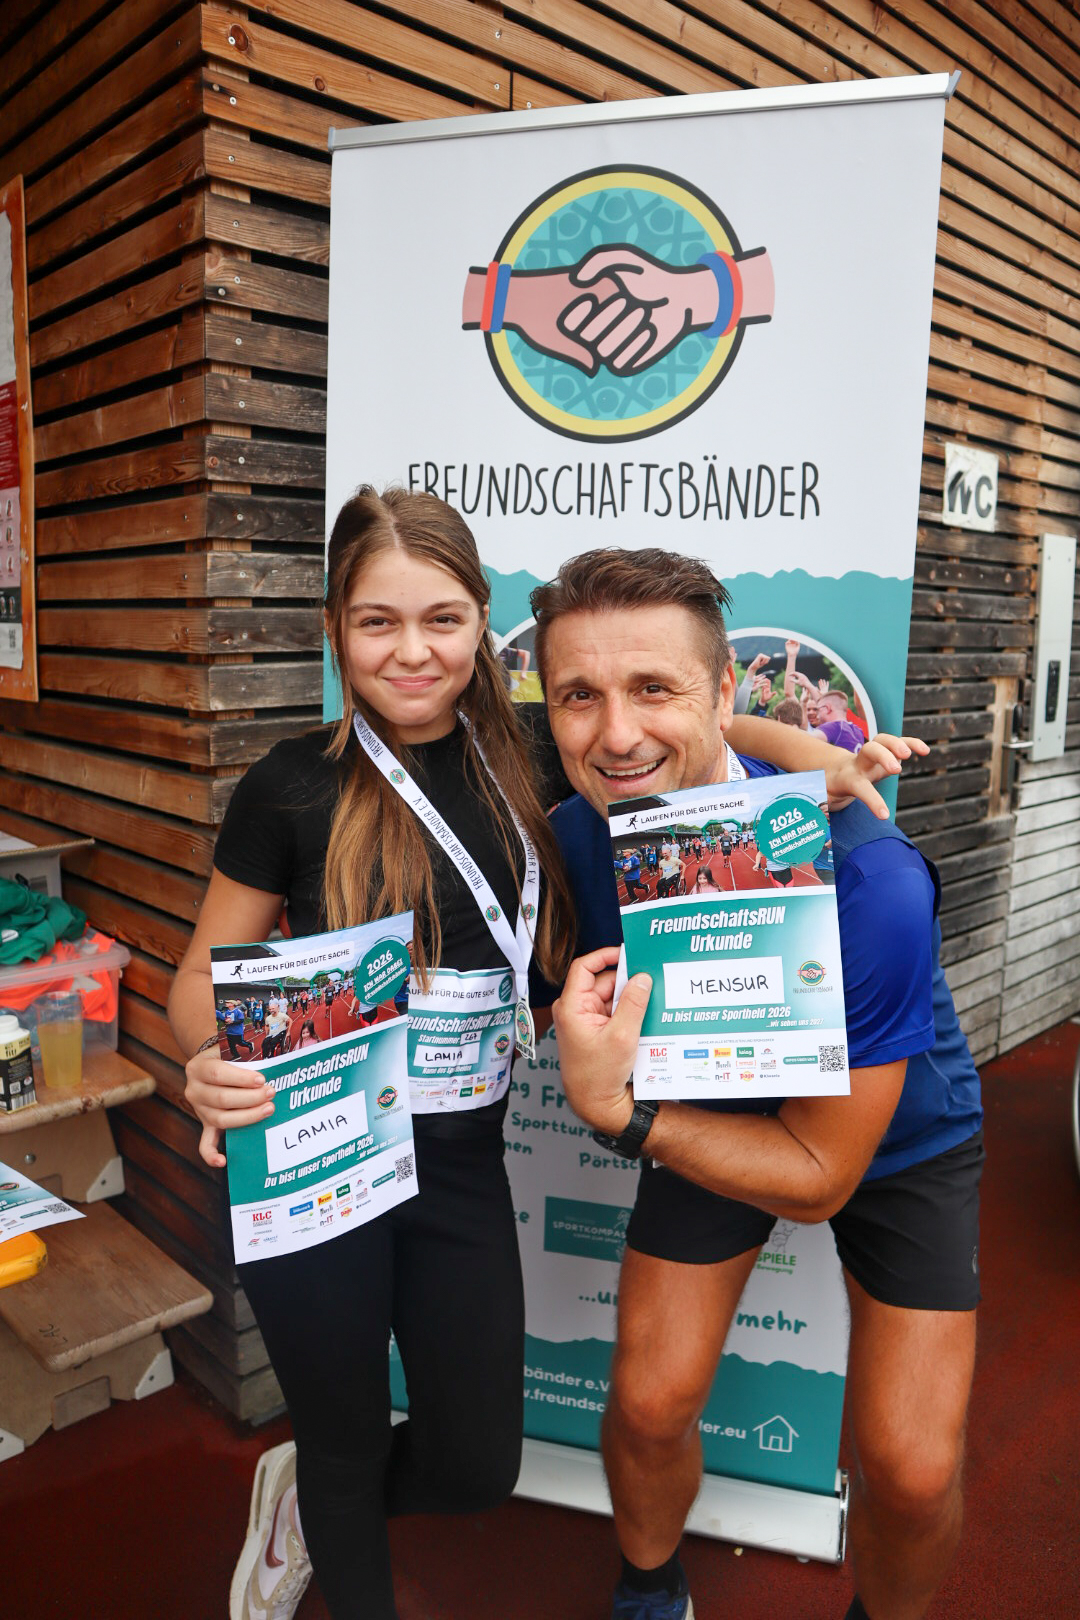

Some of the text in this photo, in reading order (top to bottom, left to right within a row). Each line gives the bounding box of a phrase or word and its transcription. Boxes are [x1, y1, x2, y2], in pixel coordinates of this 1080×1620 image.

[408, 455, 820, 520] FREUNDSCHAFTSBÄNDER
[948, 470, 993, 518] WC
[640, 800, 745, 824] LAUFEN FÜR DIE GUTE SACHE
[770, 807, 803, 830] 2026
[769, 819, 819, 849] ICH WAR DABEI
[650, 906, 786, 936] FreundschaftsRUN
[690, 932, 753, 952] Urkunde
[247, 949, 350, 974] LAUFEN FÜR DIE GUTE SACHE
[367, 950, 393, 975] 2026
[408, 988, 433, 997] AUFN
[435, 989, 451, 998] FÜR
[452, 990, 465, 999] DIE
[466, 990, 482, 999] GUTE
[690, 974, 769, 995] MENSUR
[407, 1009, 513, 1032] eundschaftsRUN 2026
[661, 1006, 791, 1023] Du bist unser Sportheld 2026
[809, 1018, 824, 1026] 2027
[425, 1050, 462, 1061] LAMIA
[650, 1047, 667, 1057] KLC
[264, 1043, 369, 1093] eundschaftsRUN
[289, 1076, 342, 1110] Urkunde
[541, 1085, 566, 1108] Fr
[284, 1114, 348, 1150] LAMIA
[504, 1141, 533, 1155] nen
[264, 1176, 277, 1188] Du
[278, 1169, 296, 1184] bist
[297, 1161, 320, 1179] unser
[321, 1144, 355, 1167] Sportheld
[356, 1134, 374, 1151] 2026
[579, 1152, 643, 1170] Pörtsc
[252, 1210, 272, 1222] KLC
[553, 1221, 626, 1239] SPORTKOMPAS
[757, 1252, 797, 1266] SPIELE
[736, 1310, 807, 1334] mehr
[523, 1364, 582, 1387] bänder
[523, 1388, 606, 1412] .freundsc
